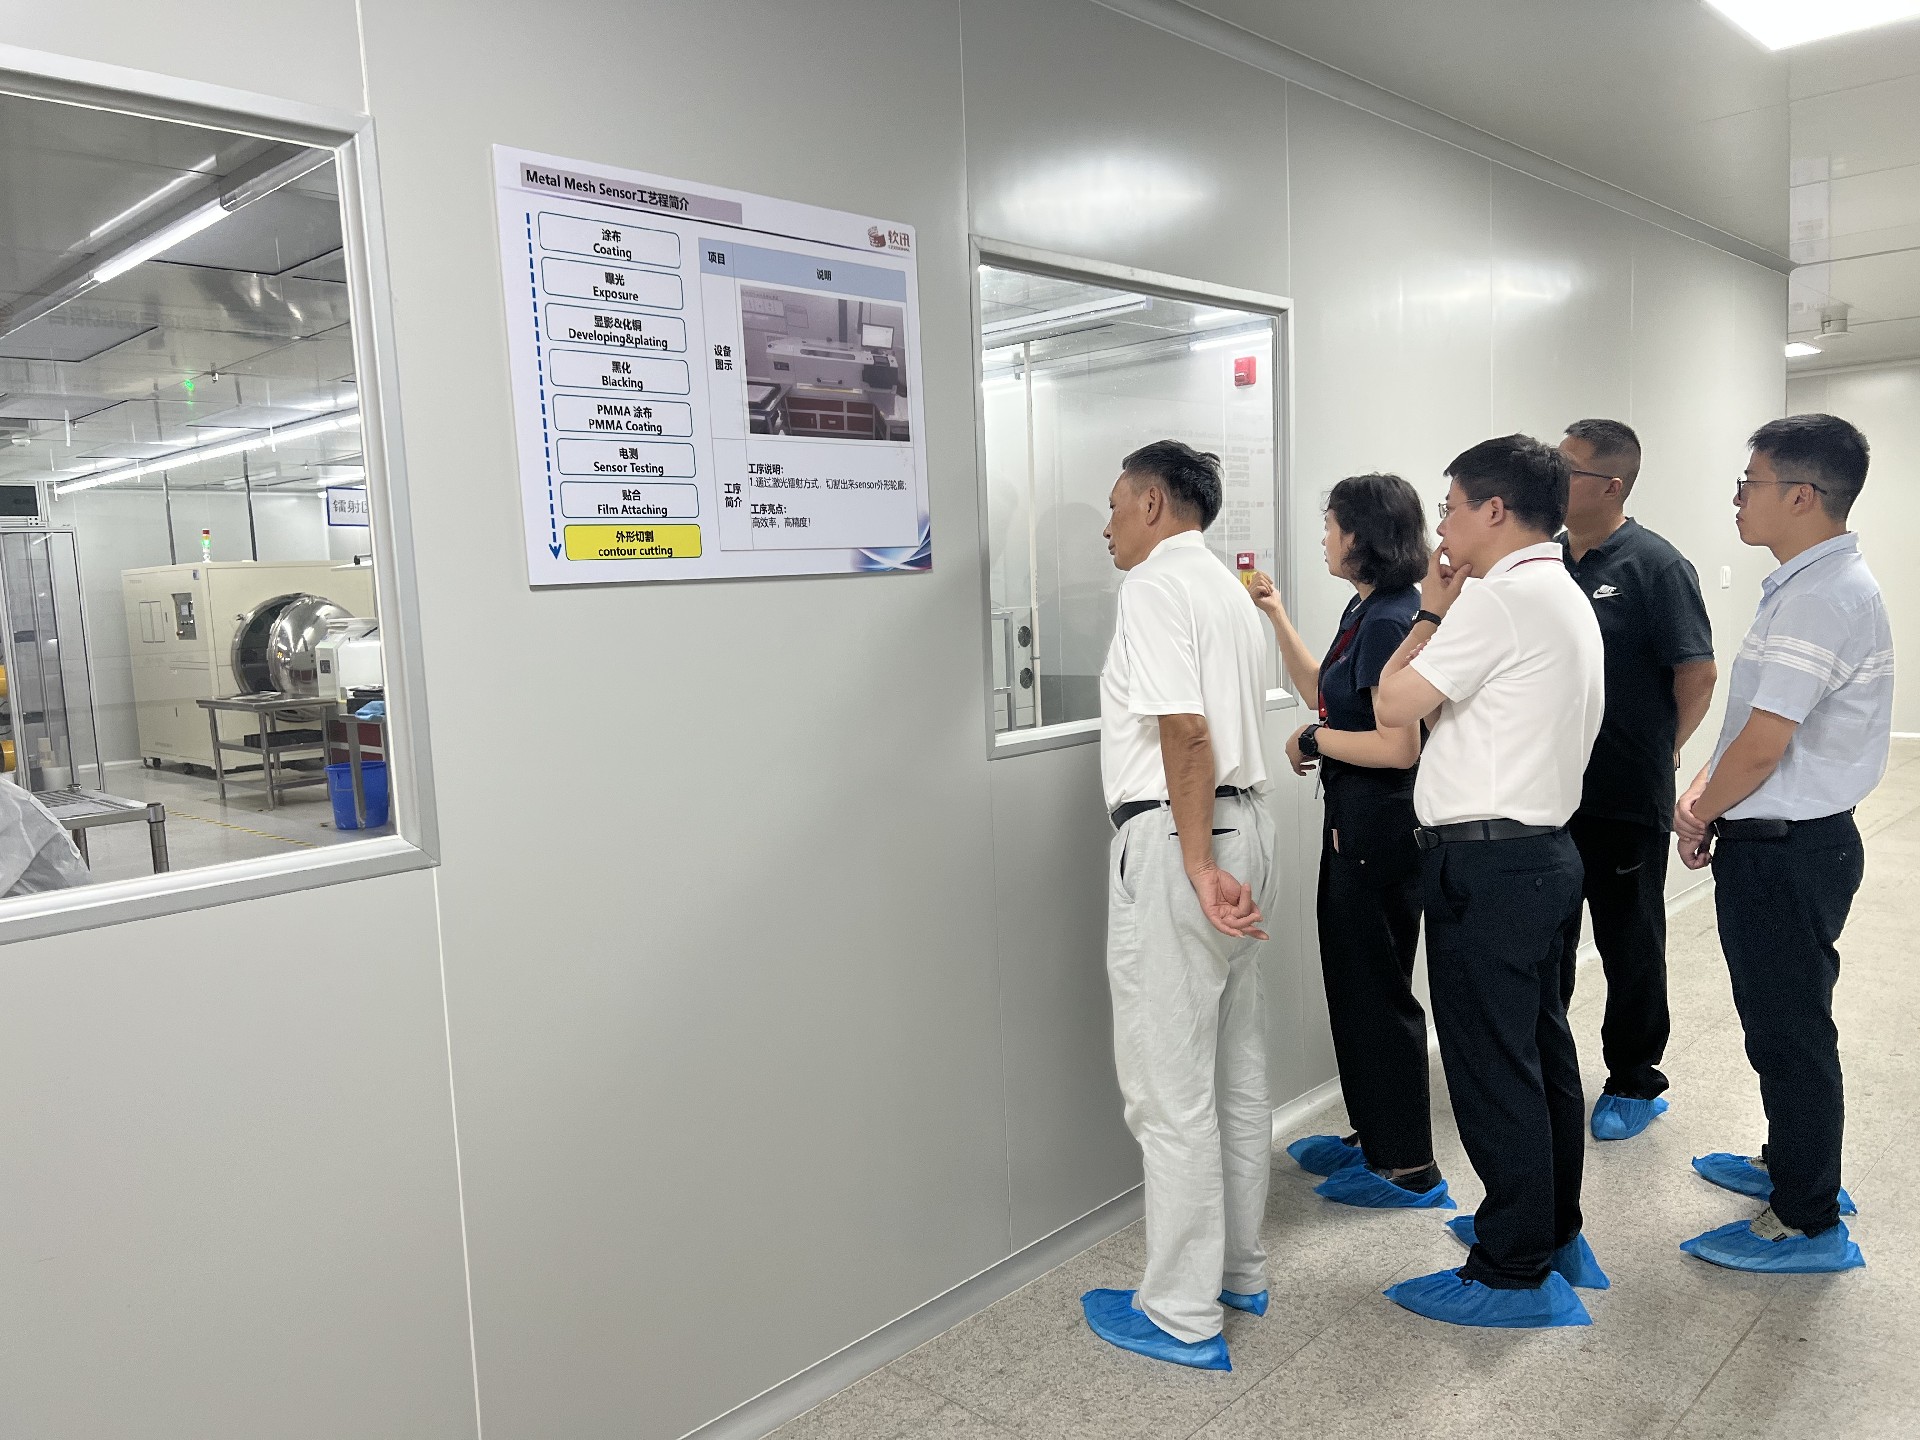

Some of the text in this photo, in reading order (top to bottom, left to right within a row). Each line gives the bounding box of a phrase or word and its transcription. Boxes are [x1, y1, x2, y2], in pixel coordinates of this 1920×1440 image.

[526, 169, 561, 188] Metal
[564, 176, 596, 193] Mesh
[601, 228, 622, 243] 涂布
[593, 243, 632, 261] Coating
[707, 250, 726, 266] 项目
[604, 272, 625, 286] 曝光
[816, 268, 832, 282] 说明
[593, 286, 639, 302] Exposure
[568, 328, 668, 351] Developing&plating
[713, 344, 731, 357] 设备
[611, 360, 632, 374] 黑化
[714, 358, 733, 371] 图示
[601, 375, 643, 391] Blacking
[597, 404, 653, 419] PMMA 涂布
[588, 418, 662, 436] PMMA Coating
[619, 447, 639, 460] 电测
[593, 461, 664, 477] Sensor Testing
[621, 488, 641, 501] 贴合
[724, 482, 742, 495] 工序
[725, 496, 743, 508] 简介
[597, 504, 668, 518] Film Attaching
[615, 530, 655, 543] 外形切割
[598, 545, 673, 558] contour cutting
